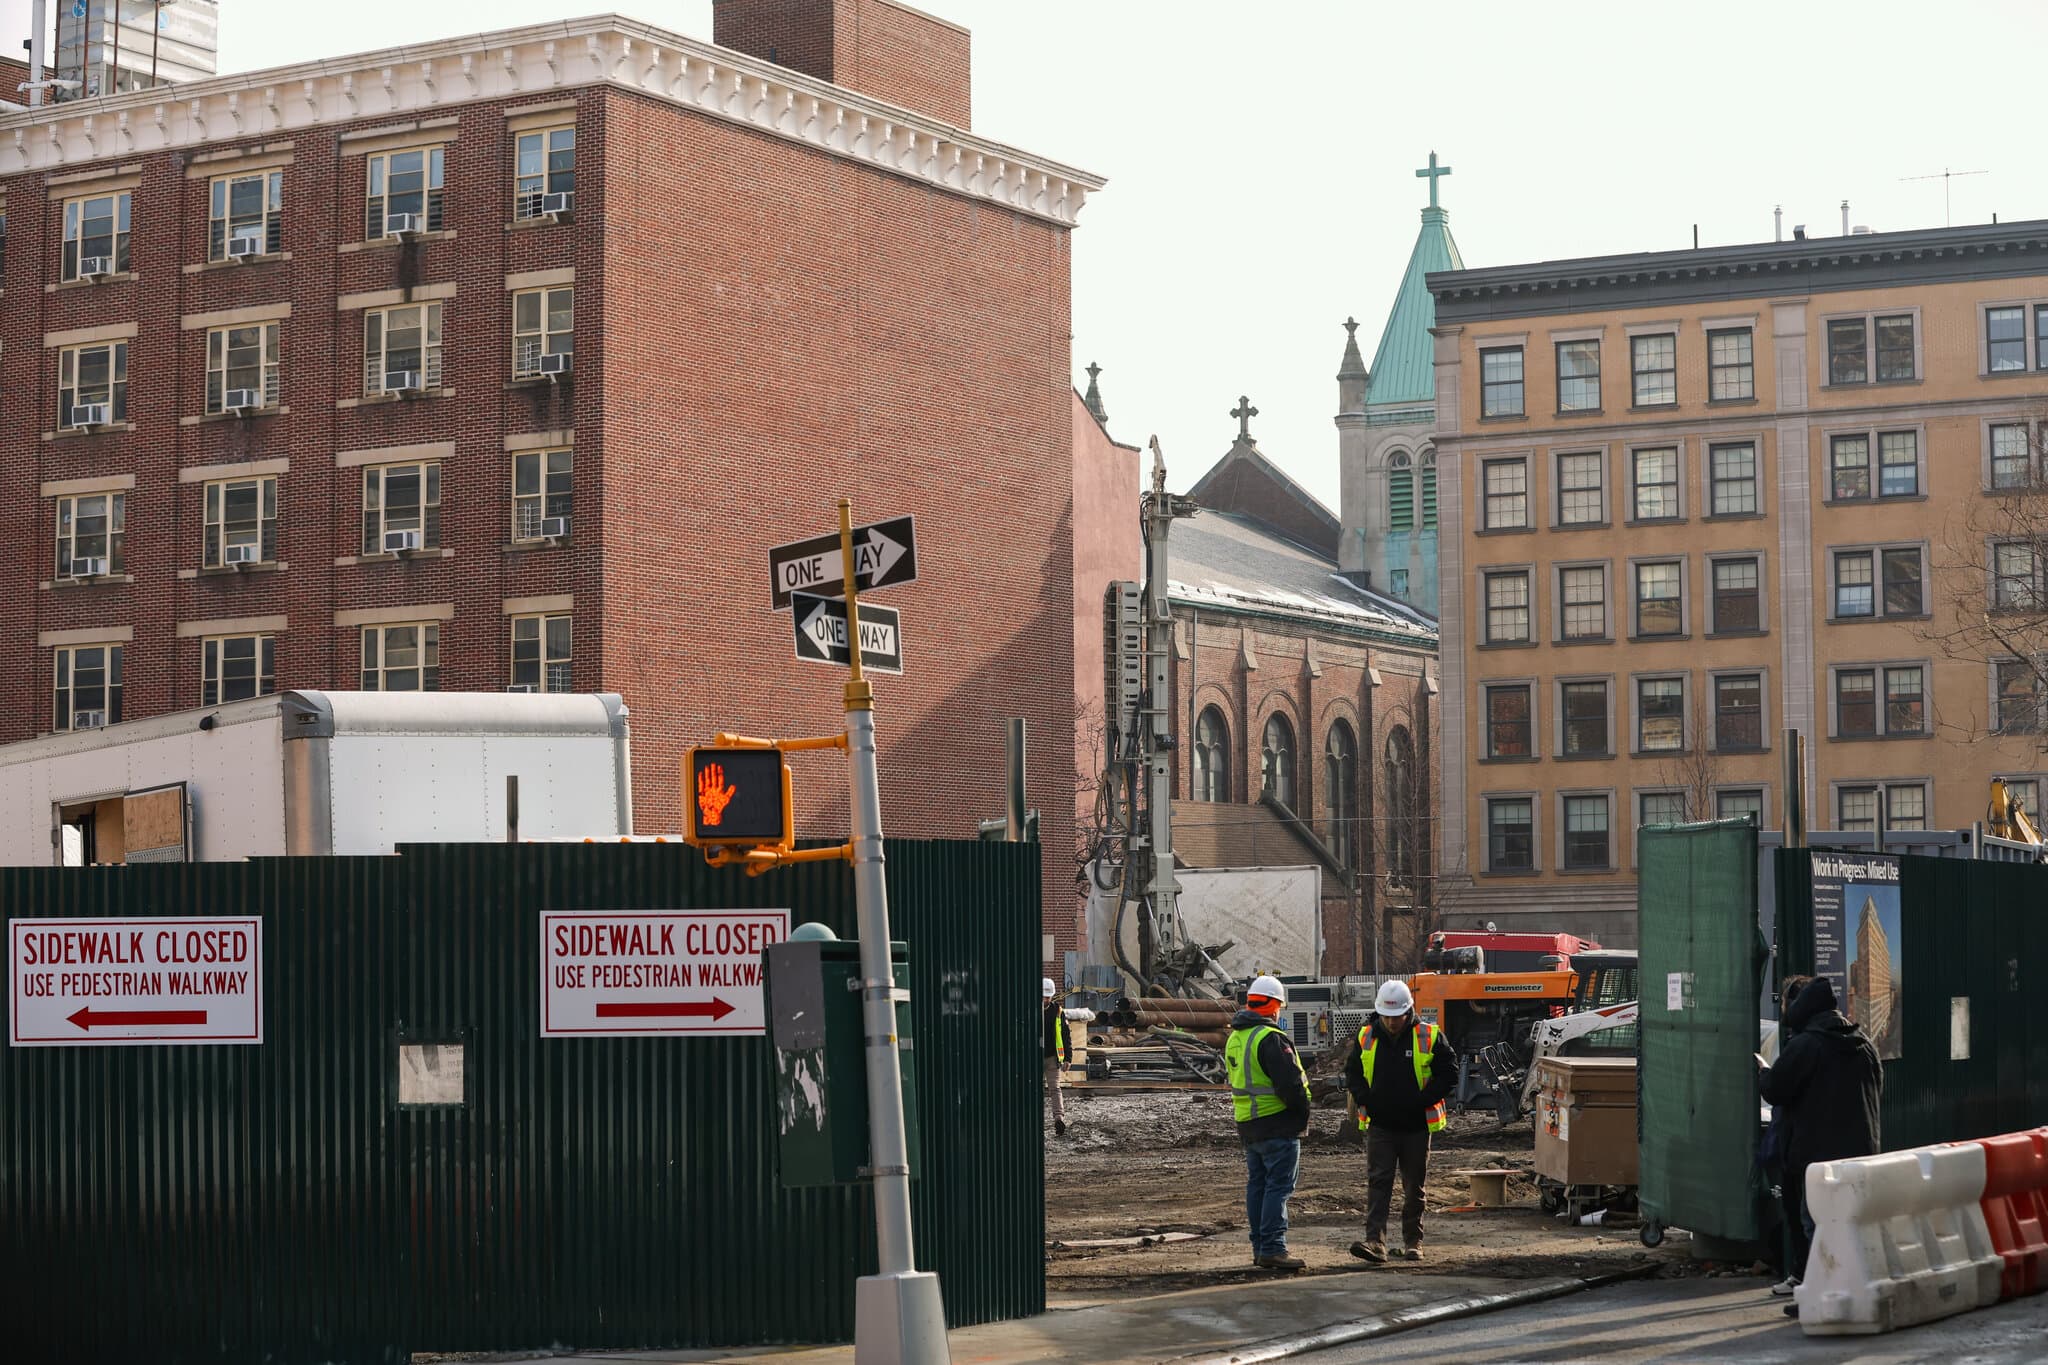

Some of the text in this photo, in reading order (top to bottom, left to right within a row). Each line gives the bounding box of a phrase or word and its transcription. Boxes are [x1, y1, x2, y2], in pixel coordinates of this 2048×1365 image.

[786, 557, 824, 587] ONE
[815, 618, 889, 651] ONE WAY
[1812, 857, 1899, 882] Work in Progress: Mixed Use
[23, 930, 248, 965] SIDEWALK CLOSED
[554, 923, 777, 957] SIDEWALK CLOSED
[24, 970, 248, 997] USE PEDESTRIAN WALKWAY
[555, 963, 765, 988] USE PEDESTRIAN WALKWA
[1485, 984, 1542, 992] Putzmeister
